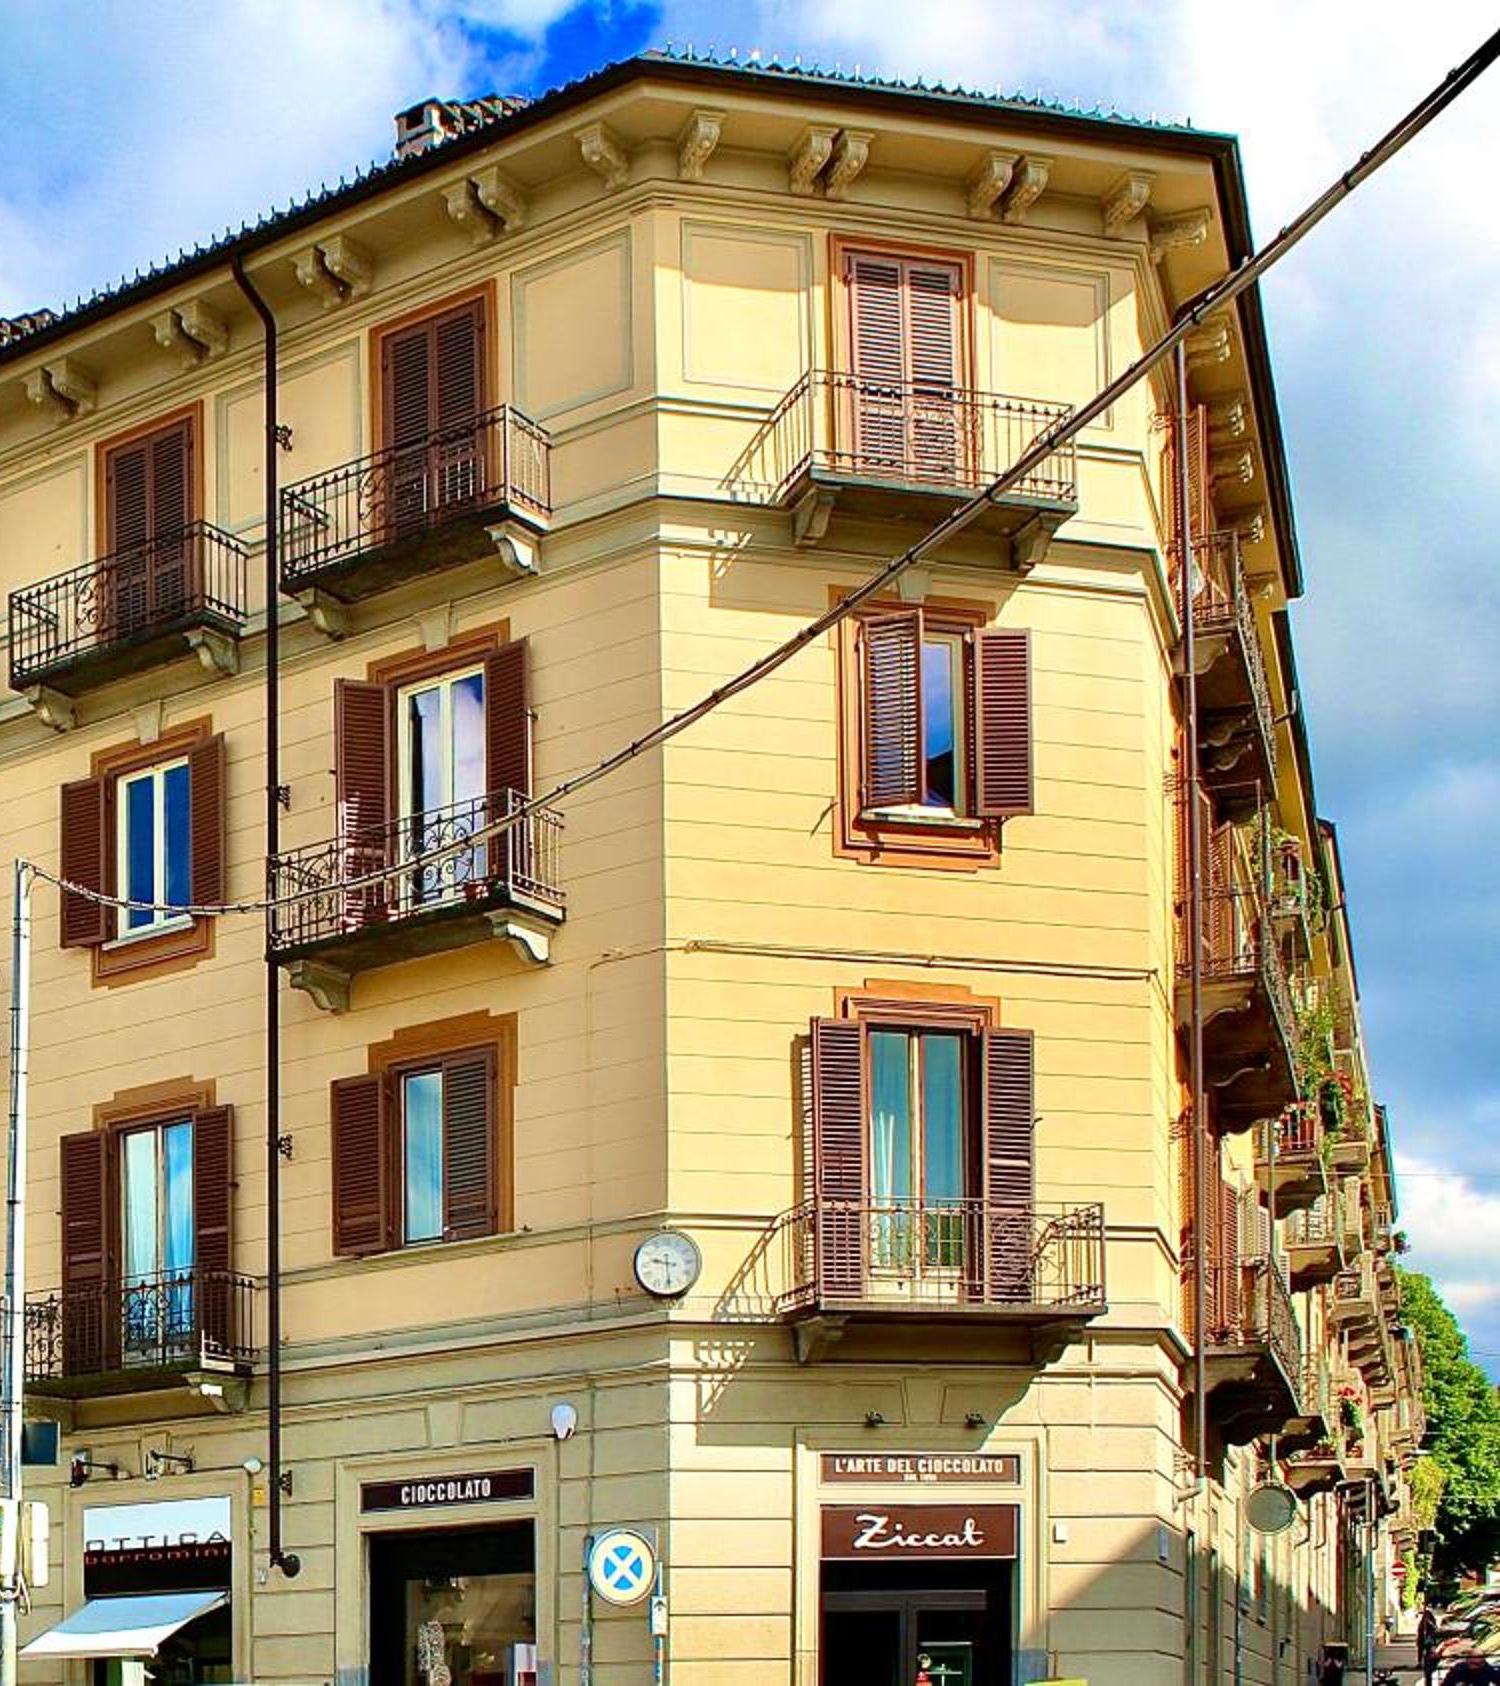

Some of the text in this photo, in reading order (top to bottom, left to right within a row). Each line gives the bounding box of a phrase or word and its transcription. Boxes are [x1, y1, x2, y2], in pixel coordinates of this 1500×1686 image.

[835, 1458, 1004, 1473] L'ARTE DEL CIOCCOLATO
[400, 1478, 492, 1505] CIOCCOLATO
[86, 1531, 228, 1553] OTTICA
[853, 1513, 985, 1549] Ziccat
